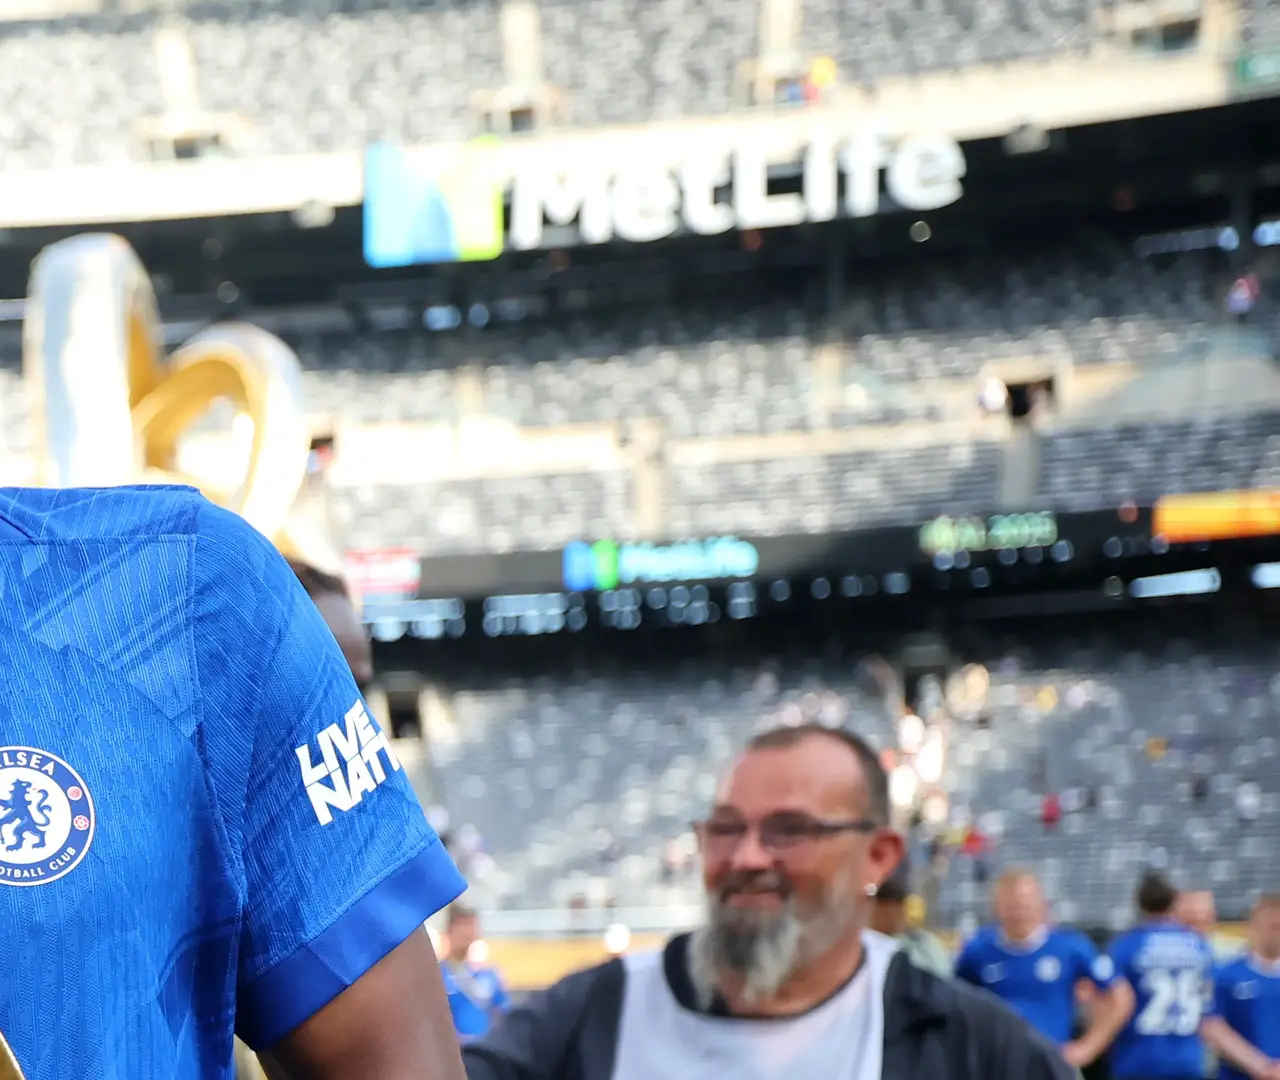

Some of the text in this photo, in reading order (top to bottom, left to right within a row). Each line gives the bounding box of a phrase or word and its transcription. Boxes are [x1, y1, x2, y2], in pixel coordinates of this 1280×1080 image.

[508, 127, 967, 250] MetLife
[294, 699, 377, 787] LIVE
[306, 730, 400, 826] NATI
[49, 846, 77, 871] CLUB
